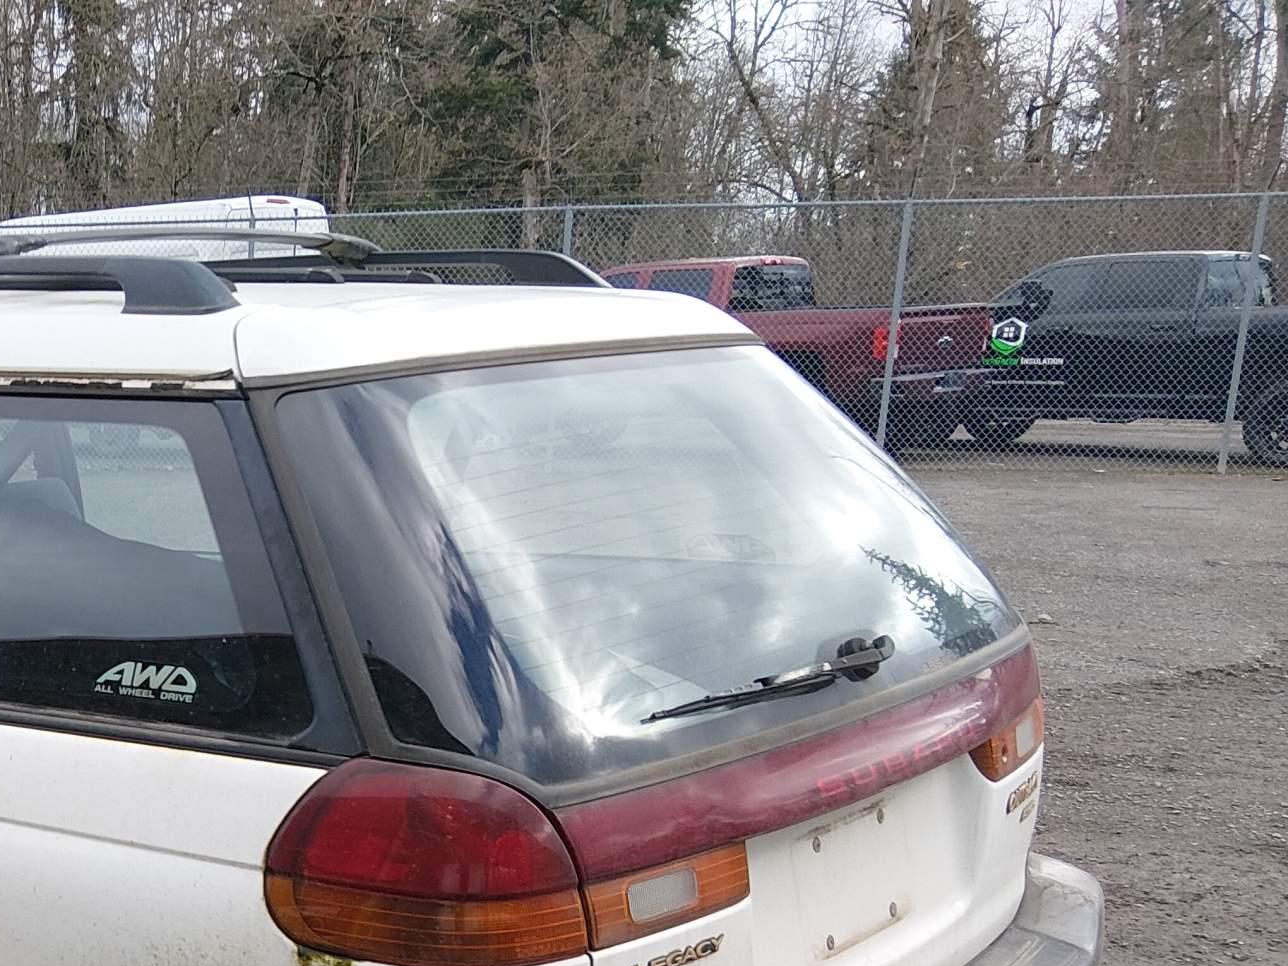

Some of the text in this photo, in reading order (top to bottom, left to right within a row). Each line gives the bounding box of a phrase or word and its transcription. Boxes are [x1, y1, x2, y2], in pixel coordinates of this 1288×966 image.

[1020, 356, 1064, 366] INSULATION
[95, 661, 197, 693] AWD
[94, 684, 194, 703] ALL WHEEL DRIVE
